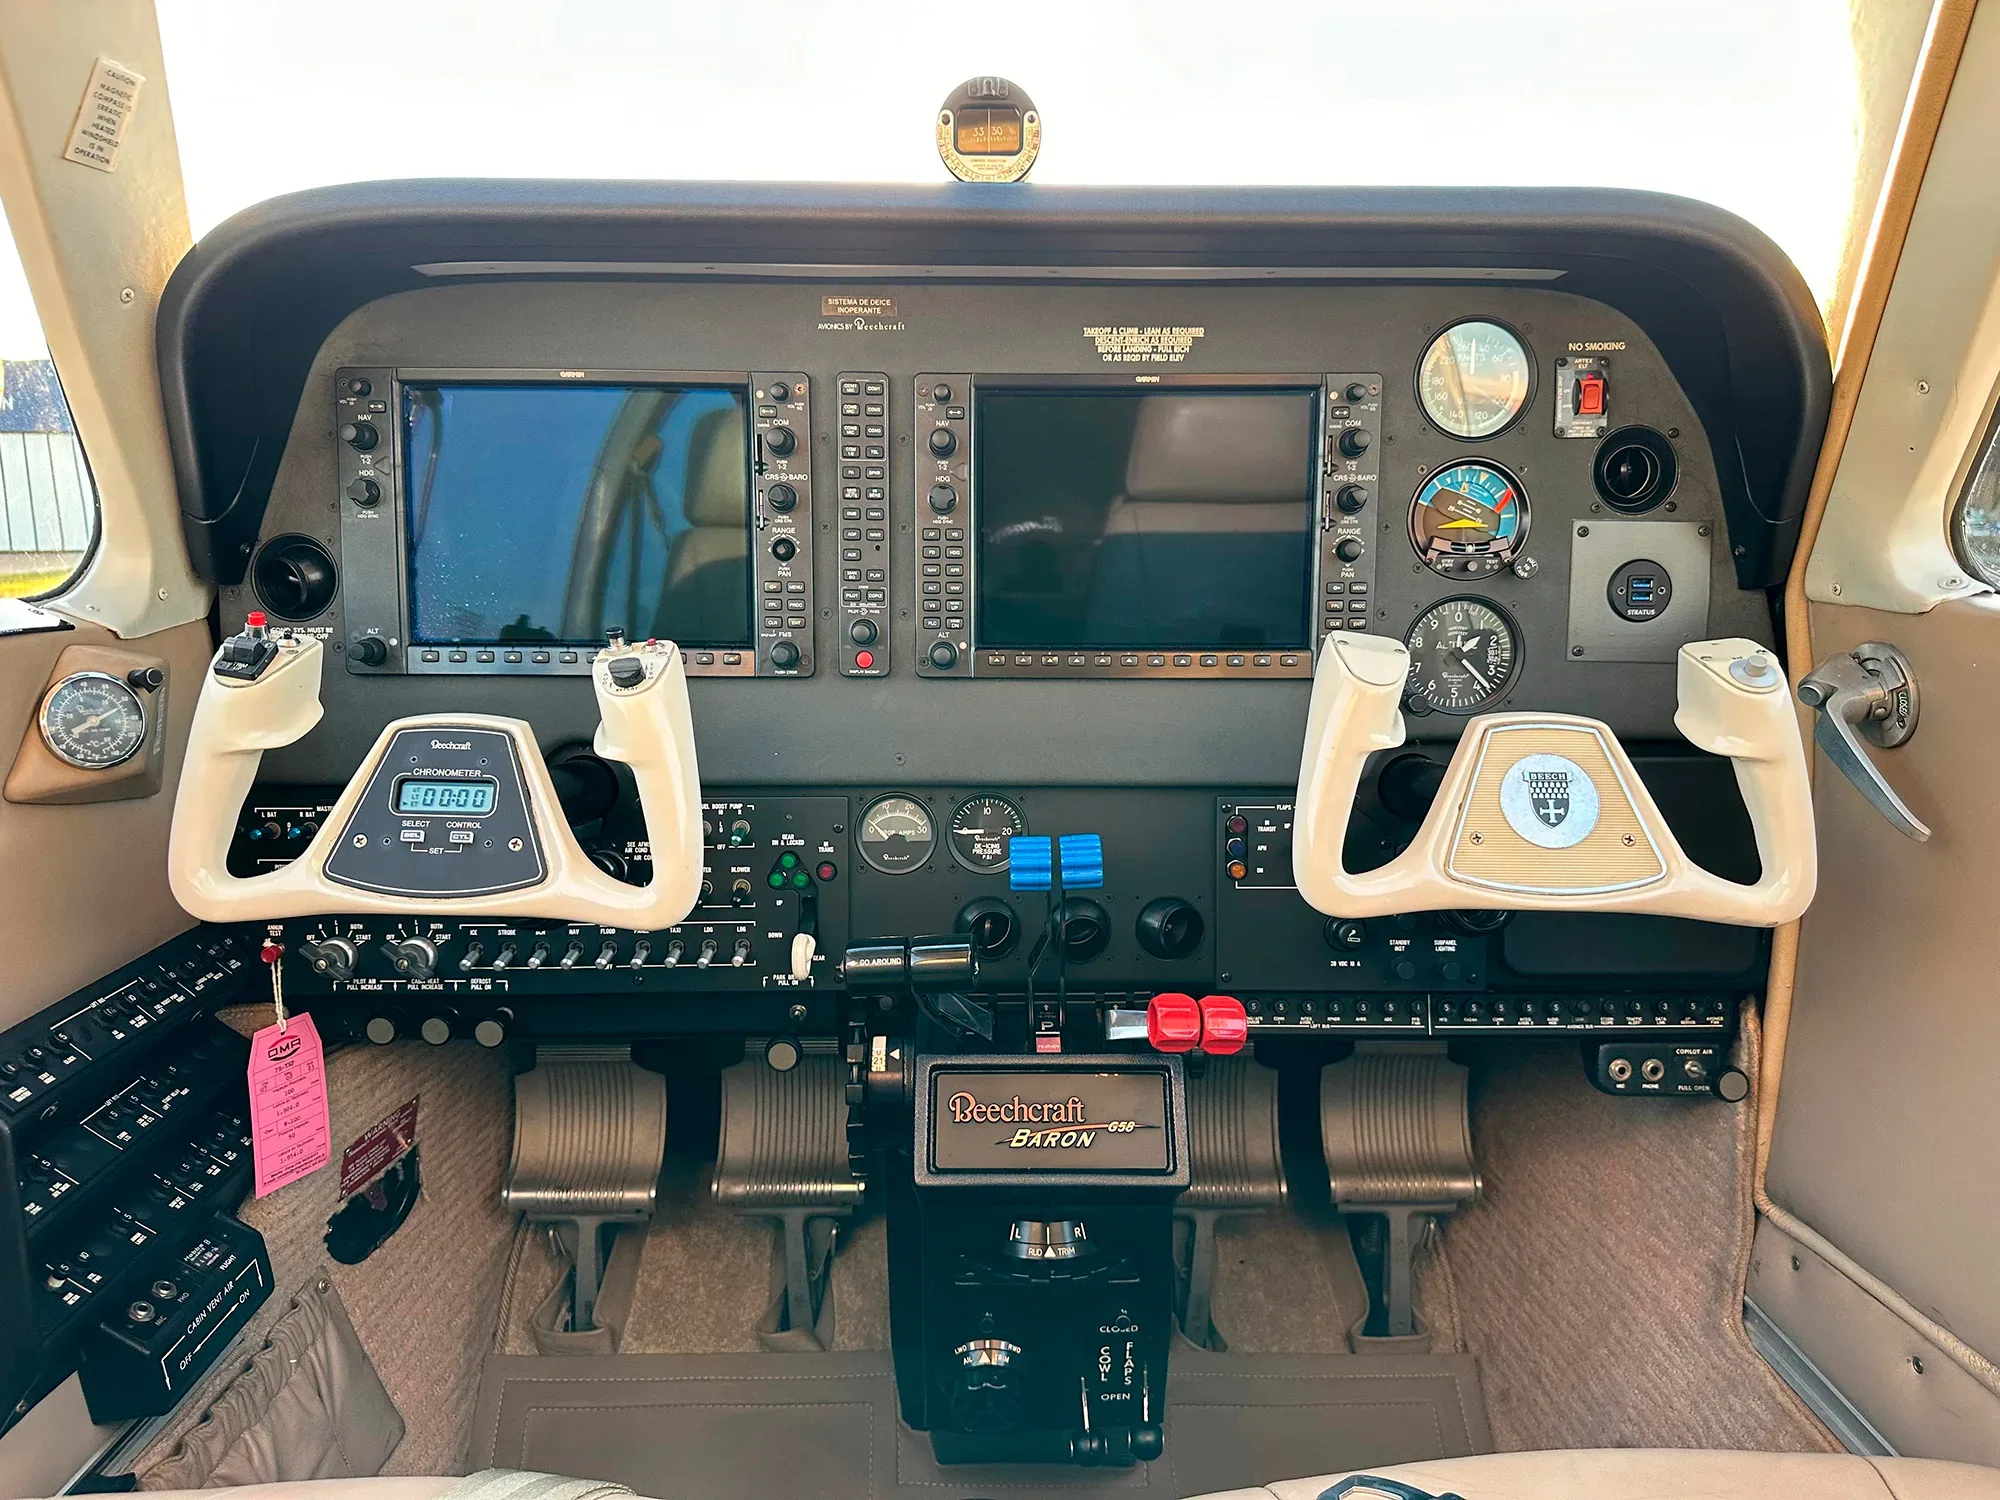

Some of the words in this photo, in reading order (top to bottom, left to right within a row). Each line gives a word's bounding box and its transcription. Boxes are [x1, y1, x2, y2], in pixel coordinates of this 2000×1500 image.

[100, 83, 133, 101] MAGNETIC
[94, 91, 125, 110] COMPASS
[97, 103, 122, 118] ERRATIC
[97, 114, 117, 126] WHEN
[91, 122, 116, 136] HEATED
[973, 127, 984, 137] 33
[991, 126, 1003, 136] 30
[81, 129, 120, 148] WINDSHIELD
[74, 147, 110, 165] OPERATION
[854, 318, 905, 331] Beechcraft
[1083, 327, 1112, 335] TAKEOFF
[1118, 327, 1138, 335] CLIMB
[1144, 327, 1161, 335] LEAN
[1162, 327, 1170, 335] AS
[1172, 327, 1204, 335] REQUIRED
[1150, 336, 1159, 344] AS
[1160, 336, 1192, 344] REQUIRED
[1568, 342, 1584, 351] NO
[1585, 342, 1626, 350] SMOKING
[1432, 377, 1444, 385] 180
[1434, 392, 1448, 400] 160
[1455, 612, 1462, 622] 0
[1431, 620, 1438, 630] 9
[1416, 637, 1422, 648] 8
[1490, 636, 1498, 646] 2
[1414, 662, 1422, 673] 7
[1488, 665, 1495, 676] 3
[1428, 680, 1436, 690] 6
[1451, 688, 1458, 698] 5
[430, 739, 472, 750] Beechcraft
[413, 768, 482, 778] CHRONOMETER
[1530, 772, 1567, 780] BEECH
[984, 807, 992, 816] 10
[402, 820, 430, 828] SELECT
[446, 821, 482, 829] CONTROL
[1002, 828, 1012, 836] 20
[428, 847, 444, 855] SET
[872, 958, 902, 966] AROUND
[1041, 1021, 1054, 1030] P
[268, 1038, 301, 1058] OMA
[948, 1091, 1086, 1124] Beechcraft
[364, 1109, 402, 1140] WARNING
[1108, 1120, 1136, 1134] G58
[1010, 1128, 1096, 1149] BARON
[1016, 1228, 1022, 1239] L
[1074, 1227, 1082, 1238] R
[1028, 1247, 1042, 1256] RUD
[1058, 1246, 1076, 1256] TRIM
[220, 1254, 236, 1271] FLIGHT
[240, 1288, 250, 1304] ON
[187, 1310, 206, 1335] CABIN
[206, 1294, 222, 1313] VENT
[224, 1280, 235, 1296] AIR
[954, 1344, 968, 1355] LWD
[1008, 1343, 1022, 1354] RWD
[180, 1353, 194, 1371] OFF
[995, 1354, 1010, 1364] TRIM
[1099, 1346, 1112, 1382] COWL
[1124, 1342, 1134, 1385] FLAPS
[1101, 1392, 1131, 1400] OPEN
